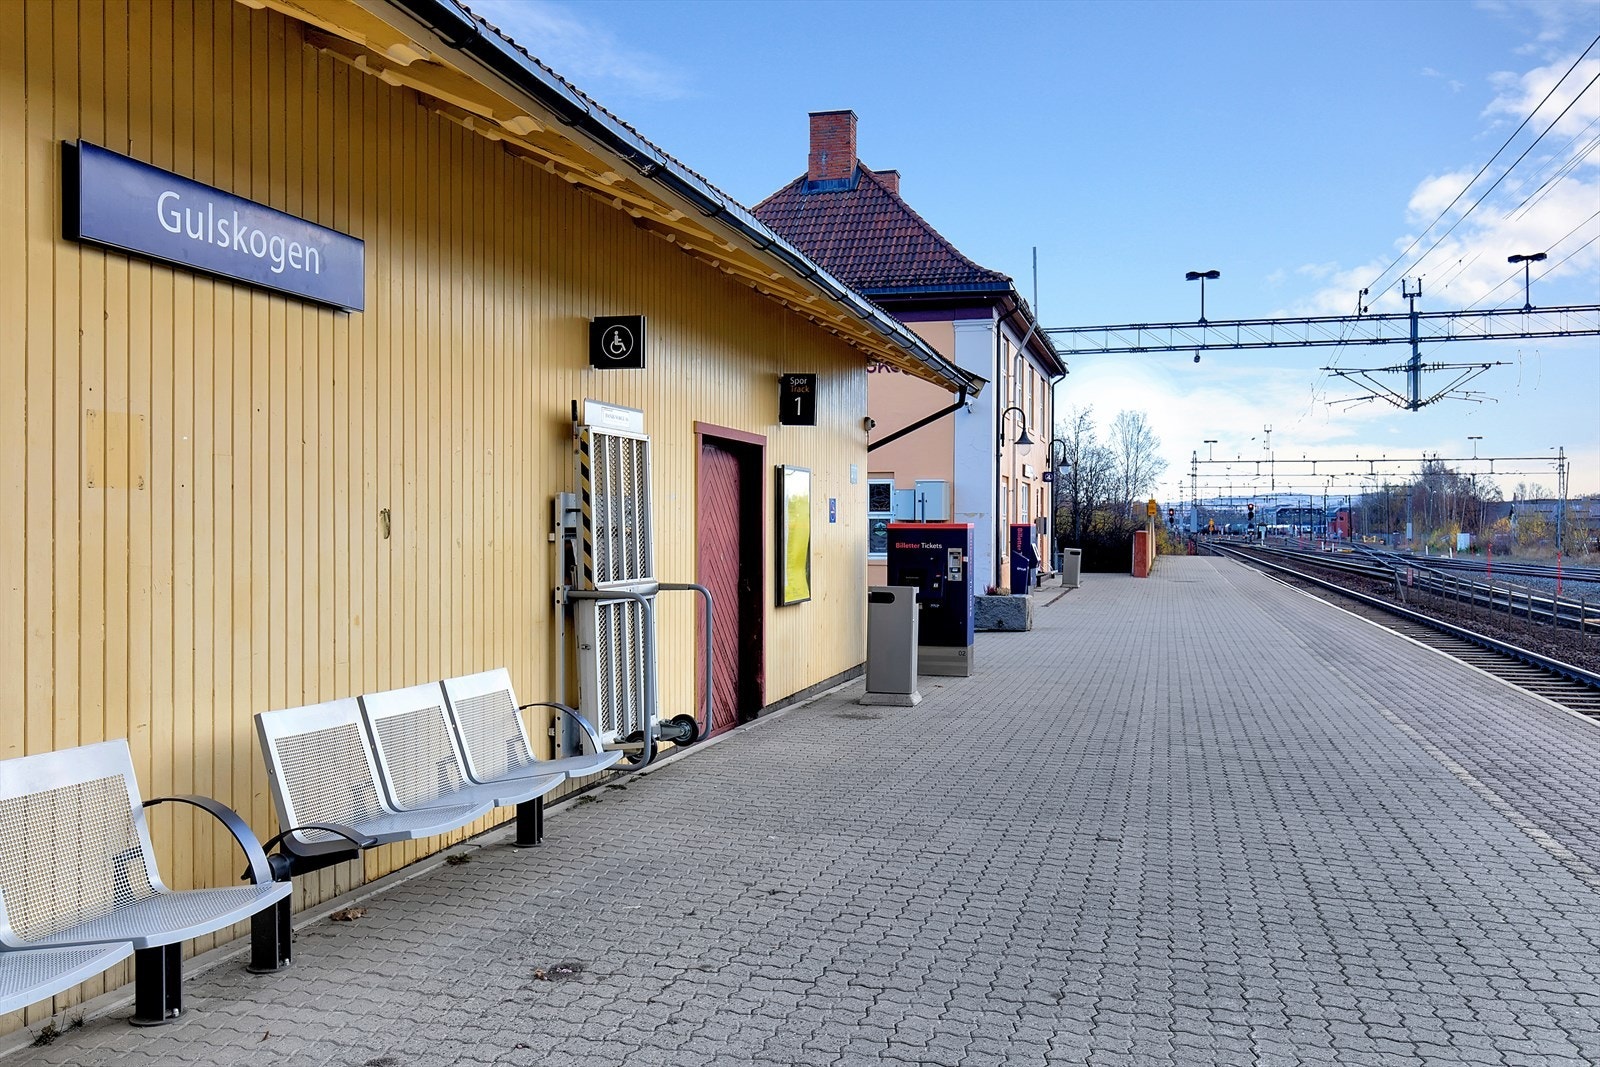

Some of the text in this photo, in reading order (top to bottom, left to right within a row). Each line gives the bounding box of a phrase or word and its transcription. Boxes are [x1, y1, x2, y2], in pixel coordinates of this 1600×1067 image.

[157, 190, 320, 274] Gulskogen
[790, 377, 807, 386] Spor
[791, 385, 810, 393] Track
[794, 396, 801, 416] 1
